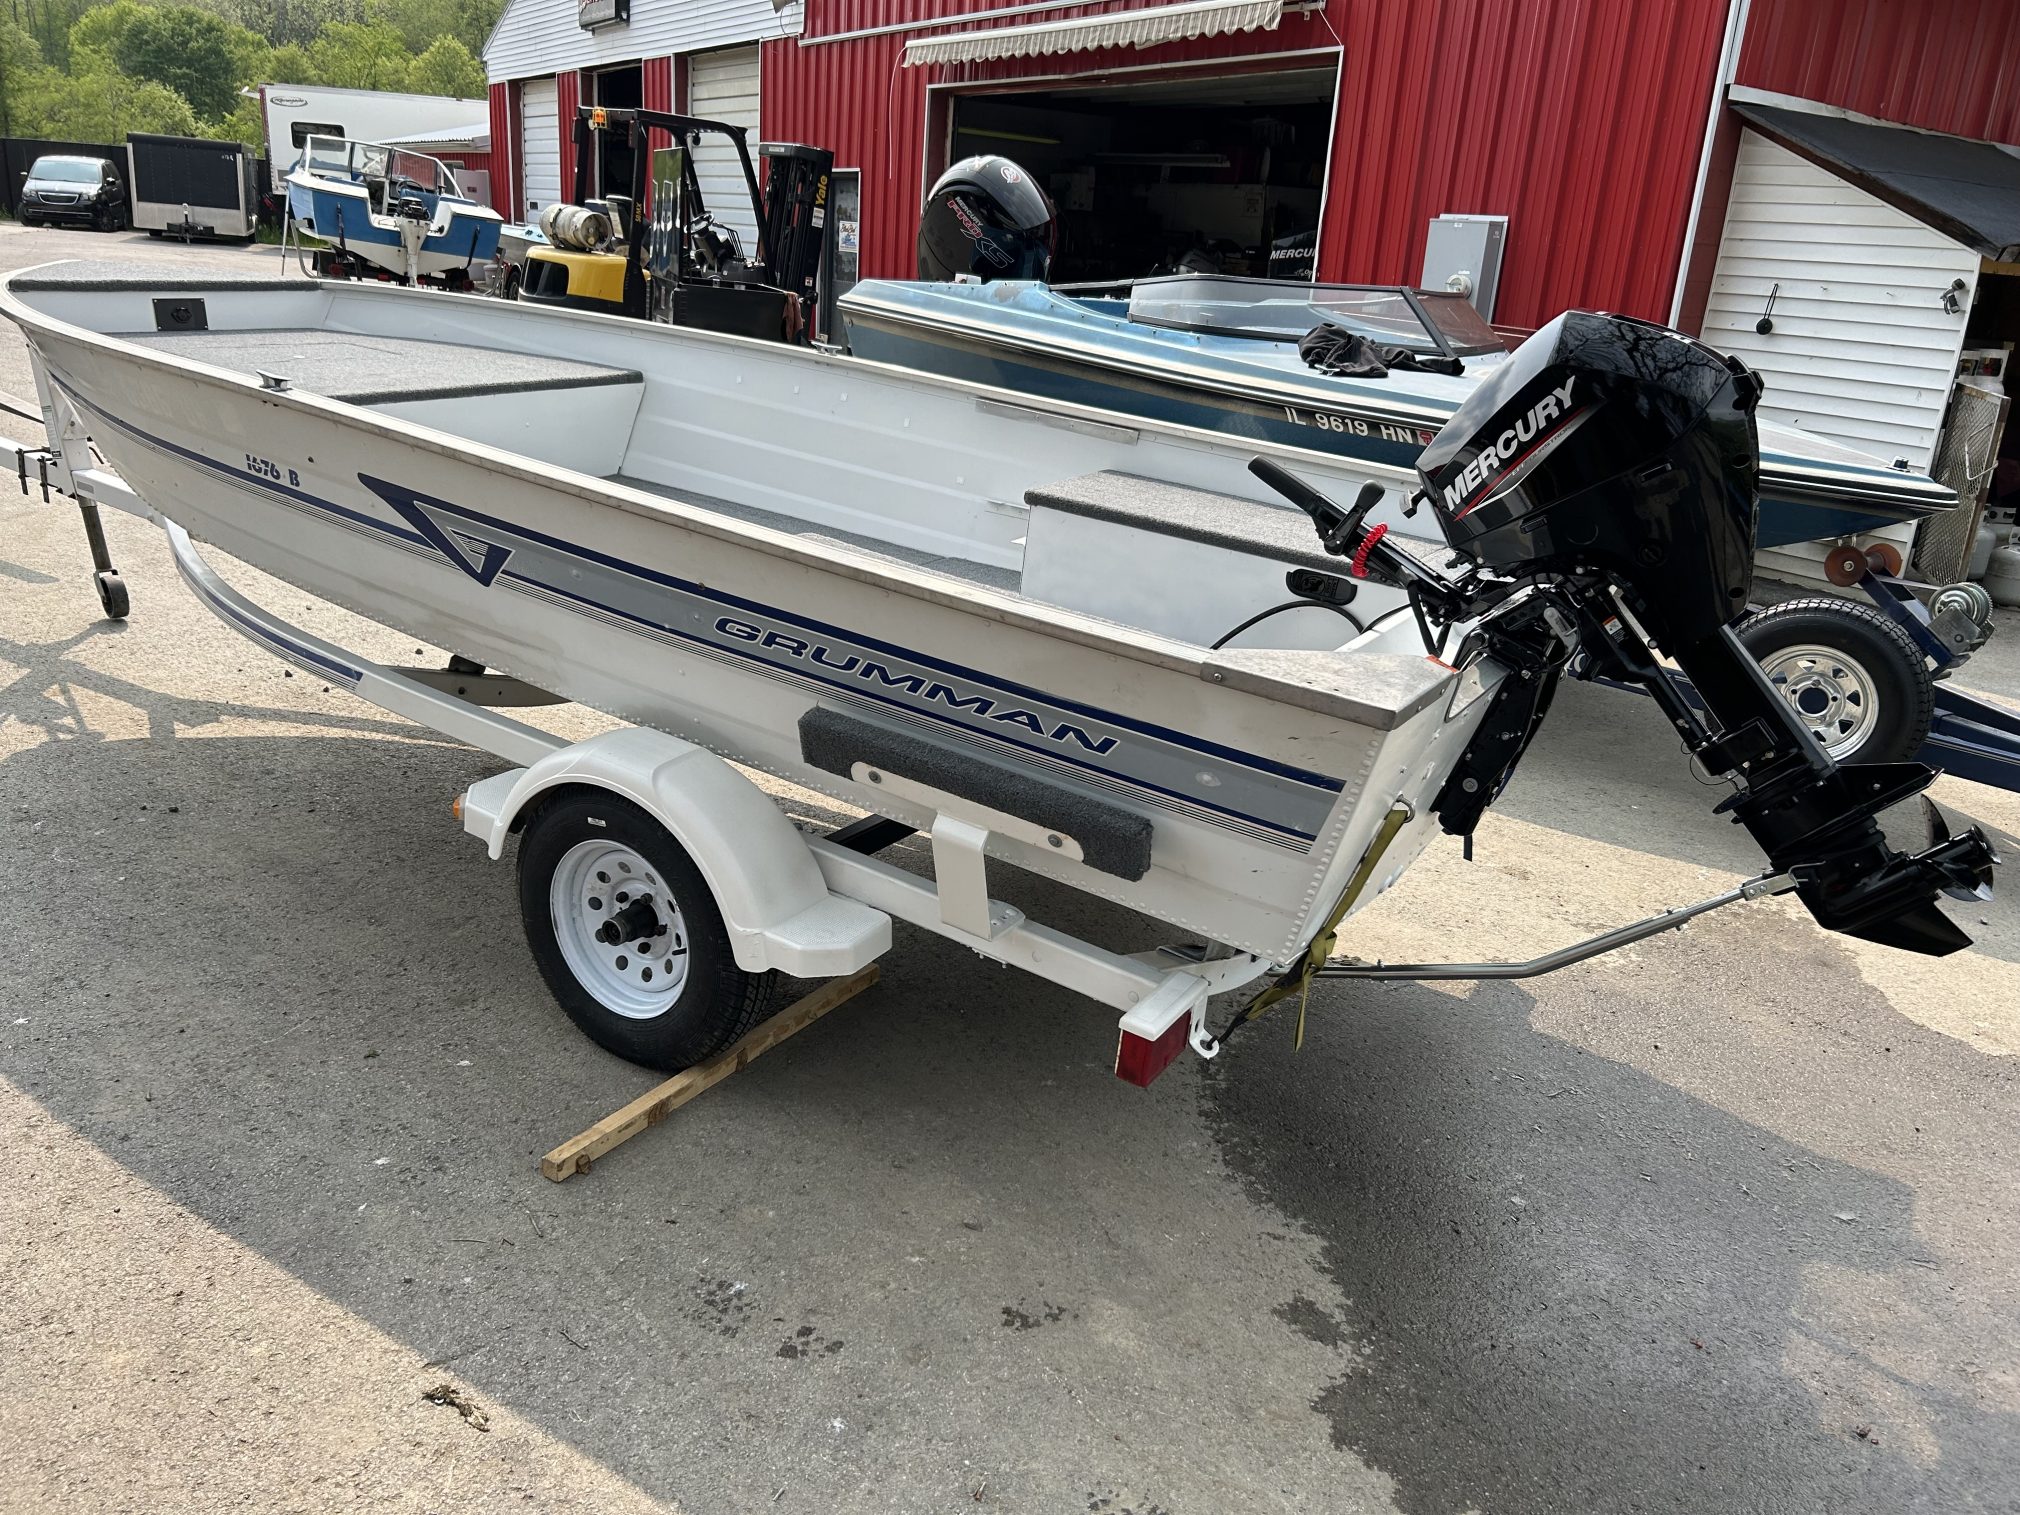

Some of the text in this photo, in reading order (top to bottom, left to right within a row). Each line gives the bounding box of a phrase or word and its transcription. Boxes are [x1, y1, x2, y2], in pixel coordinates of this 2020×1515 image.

[815, 175, 828, 205] Yale
[955, 196, 984, 227] MERCURY
[1269, 247, 1316, 260] MERCU
[1284, 406, 1306, 426] IL
[1314, 413, 1368, 437] 9619
[1379, 424, 1413, 444] HN
[1443, 375, 1576, 512] MERCURY
[288, 468, 301, 488] B
[714, 616, 1120, 756] GRUMMAN
